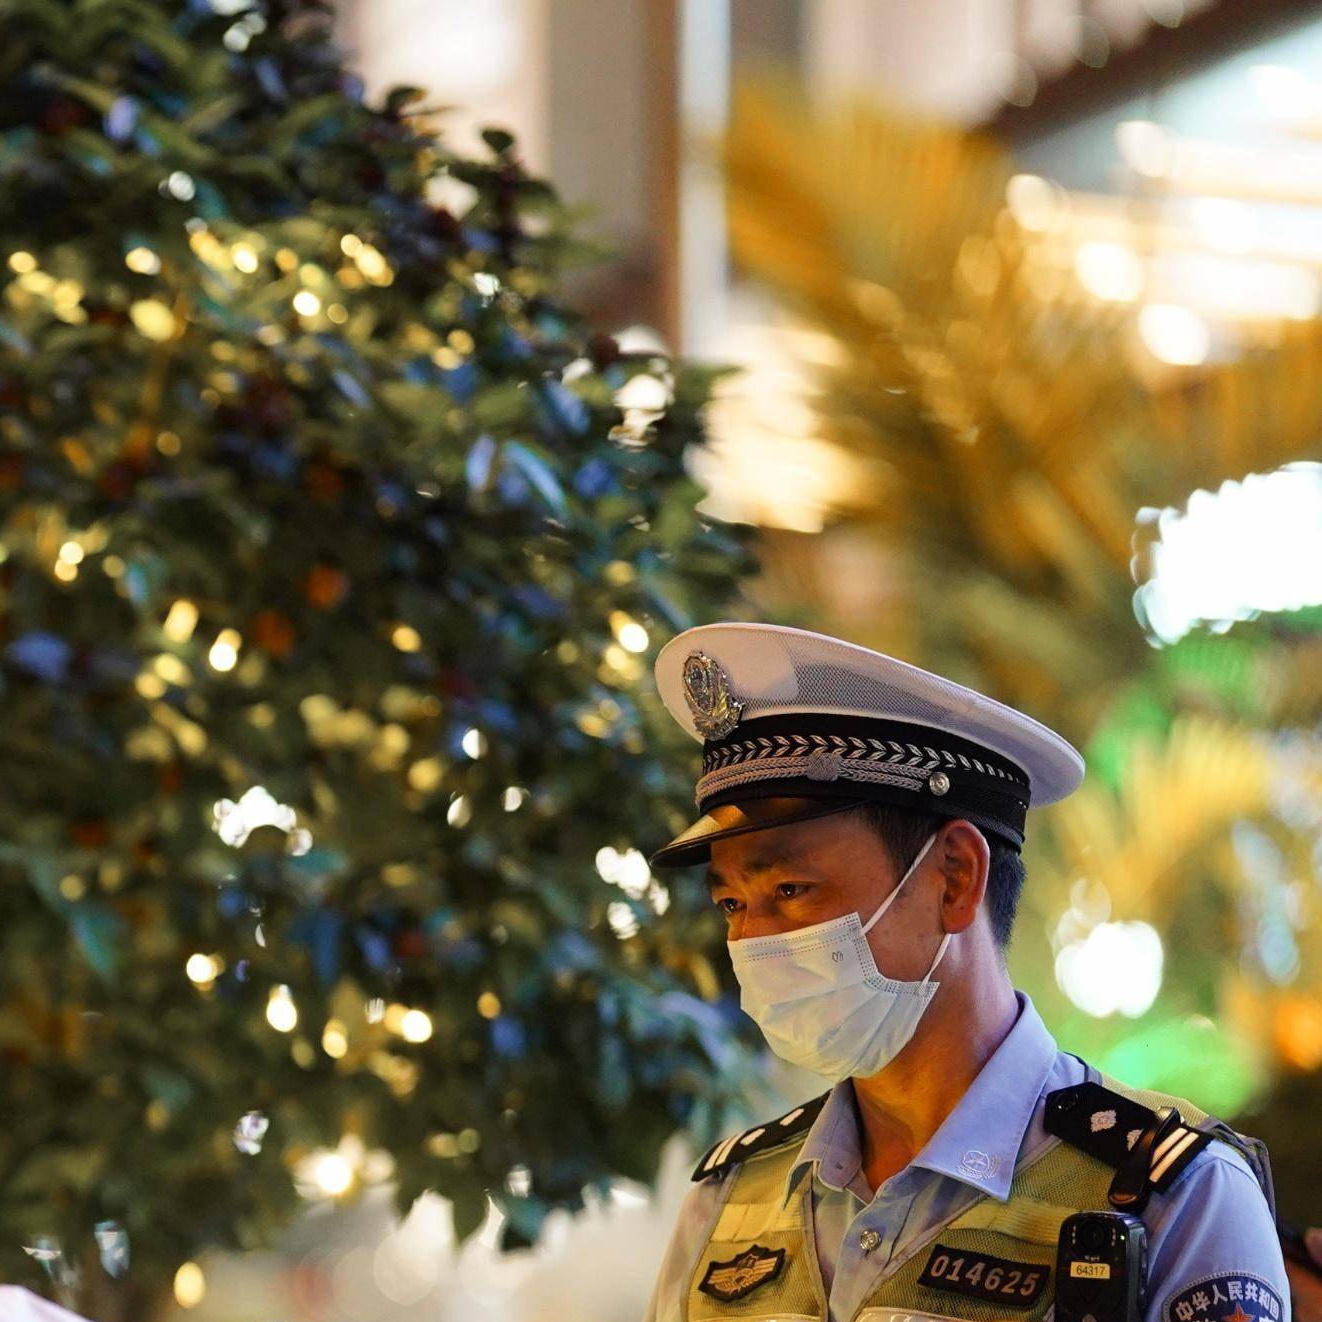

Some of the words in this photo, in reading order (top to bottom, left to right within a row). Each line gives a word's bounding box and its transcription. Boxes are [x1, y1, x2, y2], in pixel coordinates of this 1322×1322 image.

[929, 1254, 1041, 1297] 014625
[1076, 1265, 1106, 1276] 64317
[1175, 1281, 1279, 1321] 中华人民共和国
